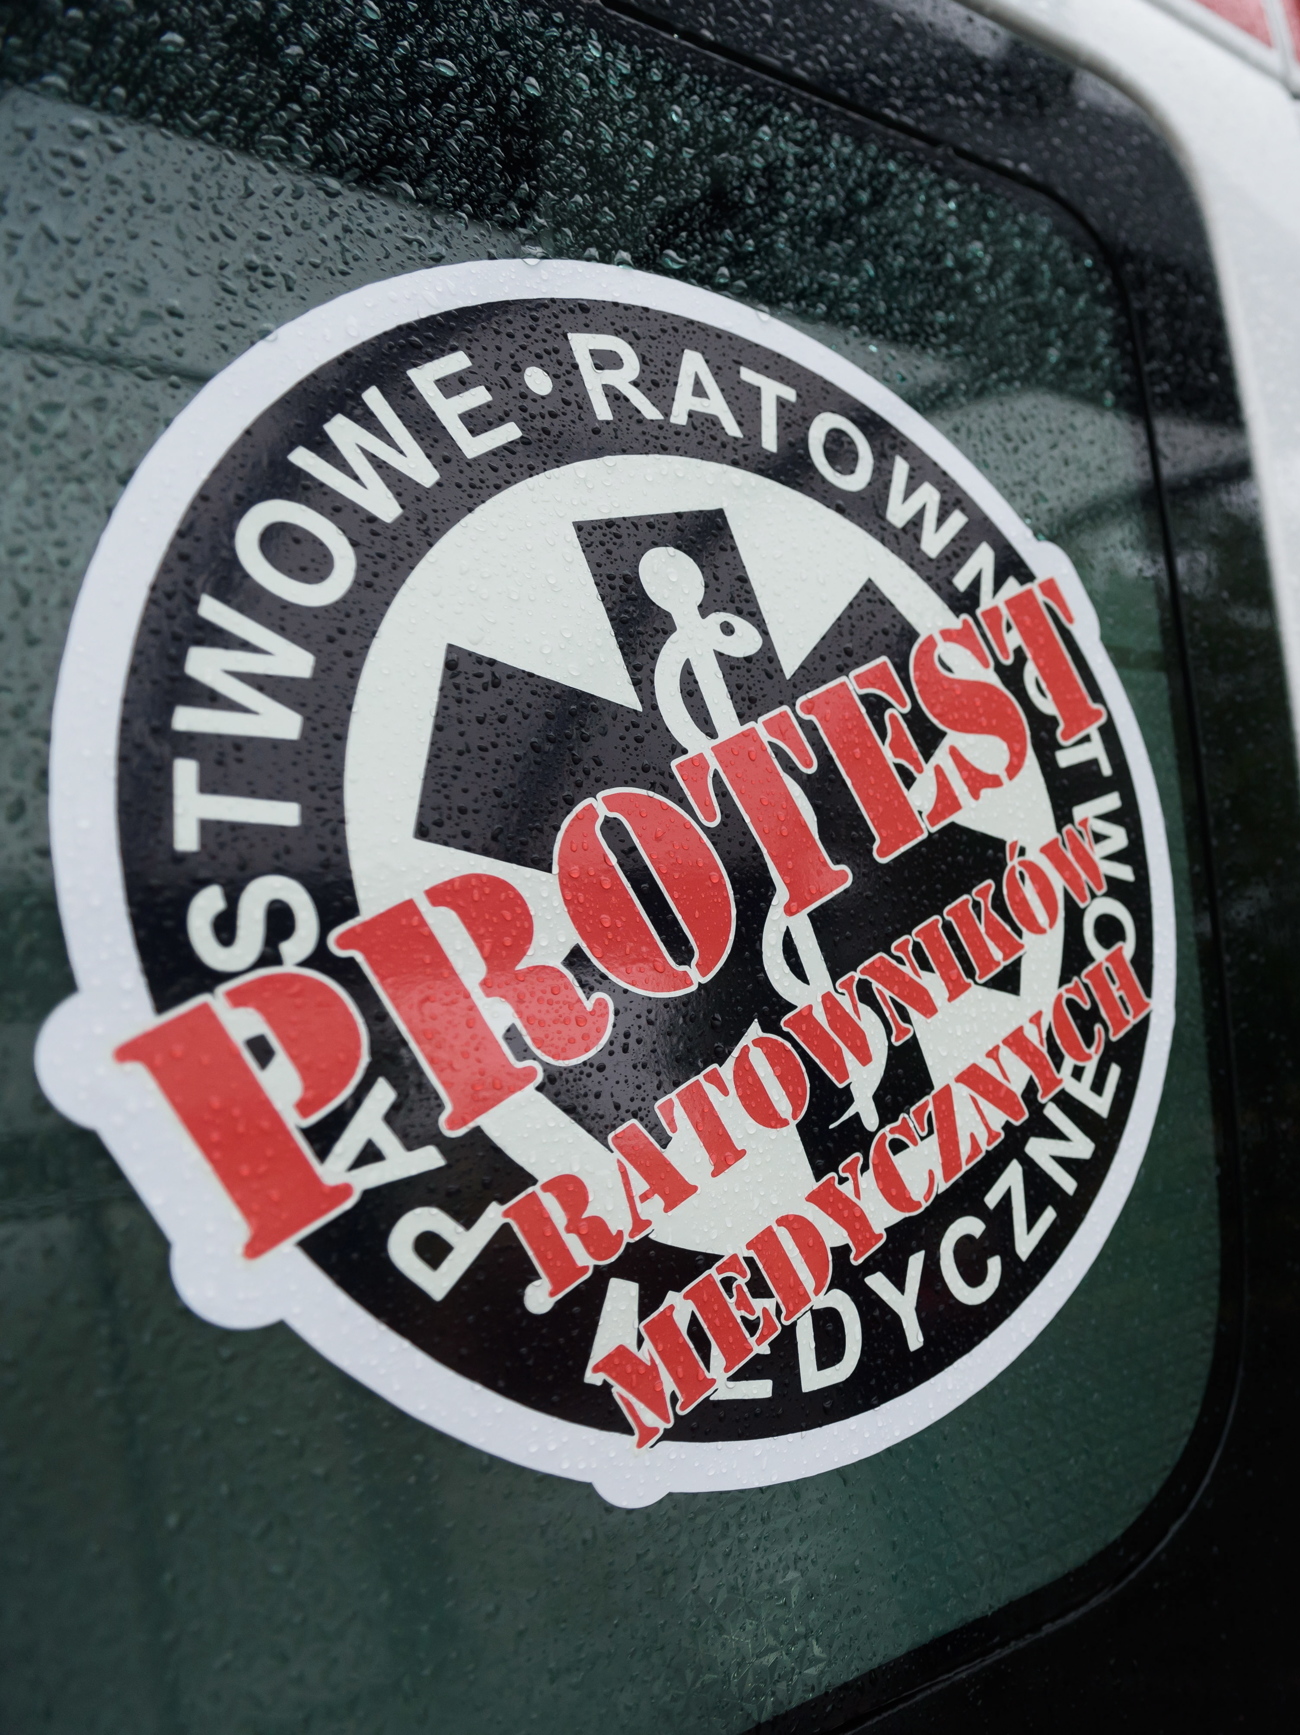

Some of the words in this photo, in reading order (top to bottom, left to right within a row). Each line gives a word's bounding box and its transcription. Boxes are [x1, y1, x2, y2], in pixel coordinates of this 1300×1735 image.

[113, 577, 1105, 1260] PROTEST
[171, 351, 522, 1301] PASTWOWE
[502, 817, 1106, 1298] RATOWNIKÓW
[591, 945, 1151, 1449] MEDYCZNYCH
